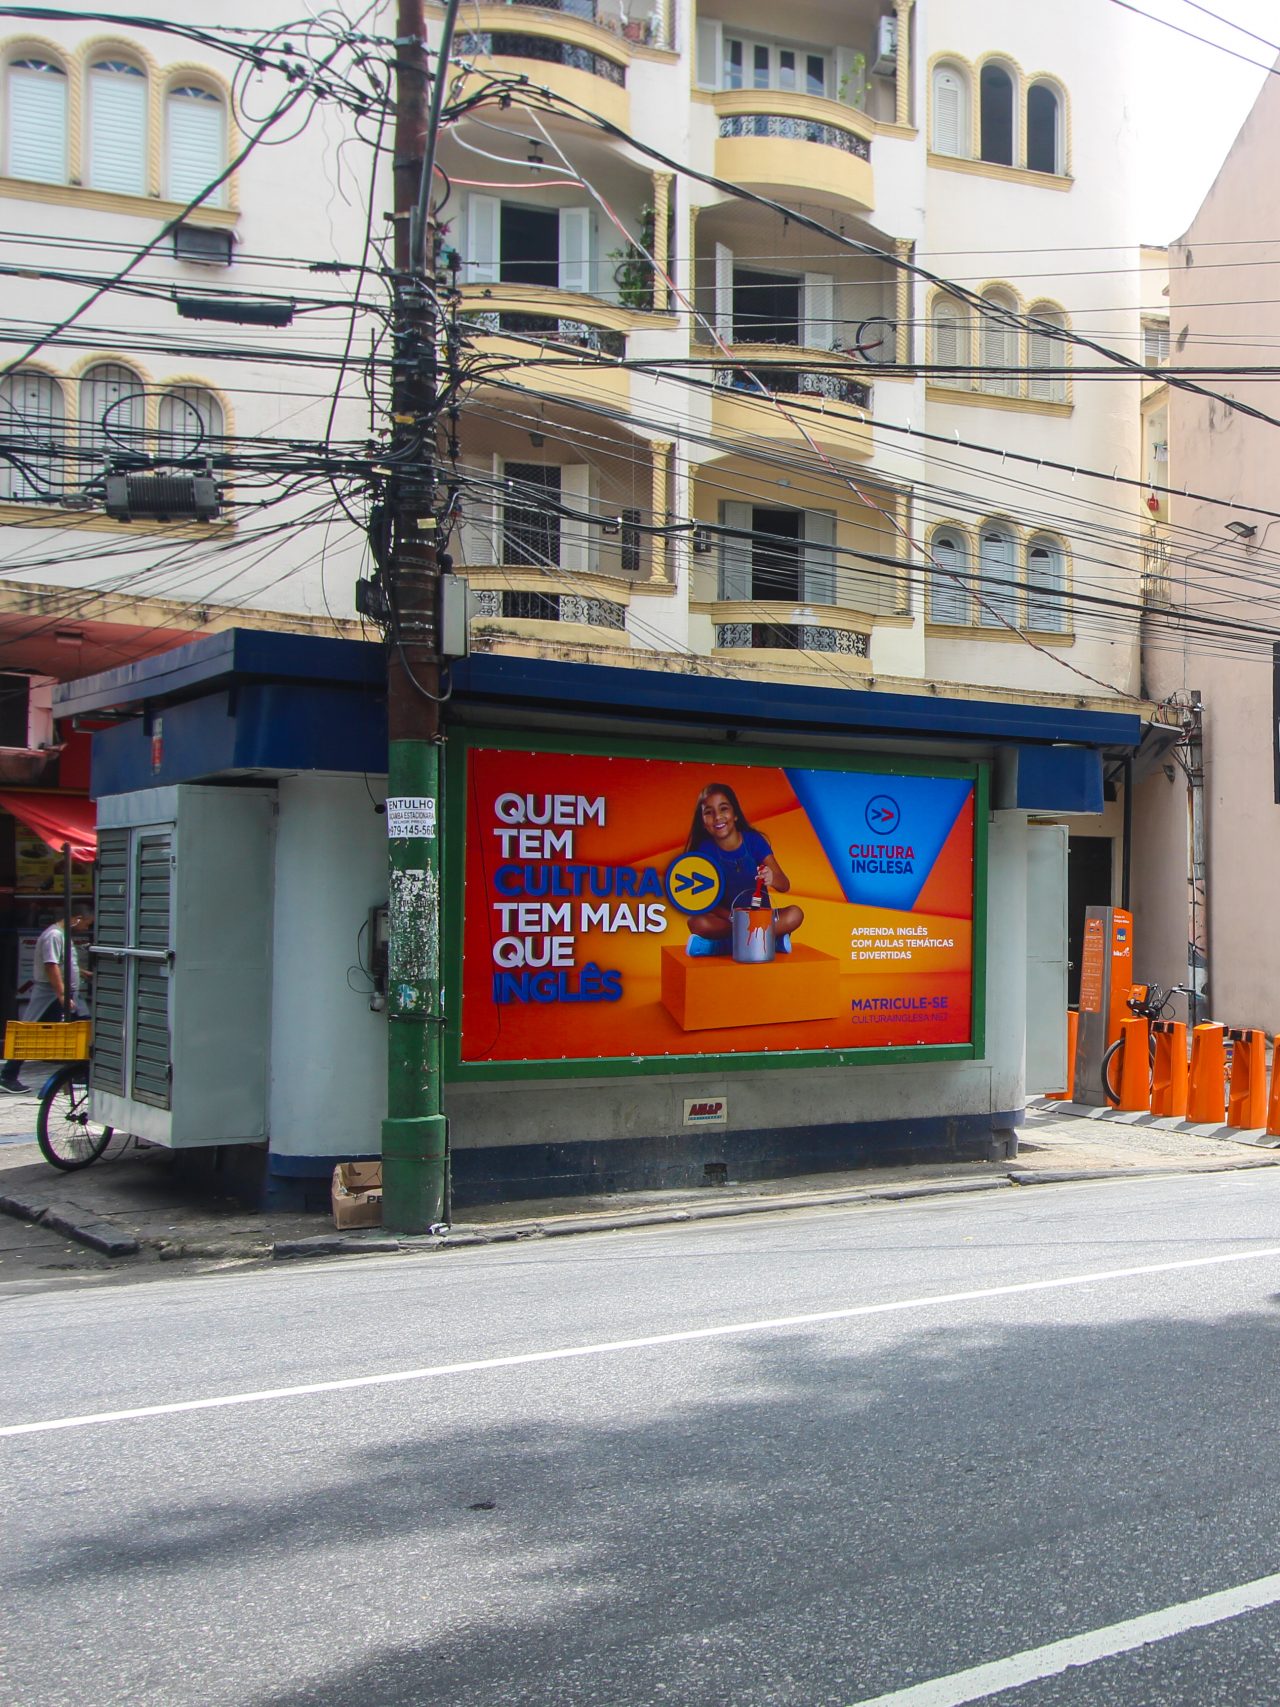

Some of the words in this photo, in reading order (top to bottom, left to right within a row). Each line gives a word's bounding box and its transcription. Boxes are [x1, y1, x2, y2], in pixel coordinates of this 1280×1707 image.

[389, 799, 434, 809] ENTULHO
[494, 792, 606, 827] QUEM
[493, 828, 573, 860] TEM
[848, 843, 915, 859] CULTURA
[851, 859, 914, 874] INGLESA
[493, 864, 664, 897] CULTURA
[493, 902, 571, 933] TEM
[581, 902, 668, 933] MAIS
[851, 927, 895, 936] APRENDA
[897, 925, 928, 936] INGLÊS
[851, 939, 872, 948] COM
[874, 939, 904, 948] AULAS
[906, 937, 954, 948] TEMÁTICAS
[492, 935, 575, 968] QUE
[851, 951, 857, 960] E
[859, 950, 912, 960] DIVERTIDAS
[492, 961, 624, 1004] INGLÊS
[851, 996, 949, 1011] MATRICULE-SE
